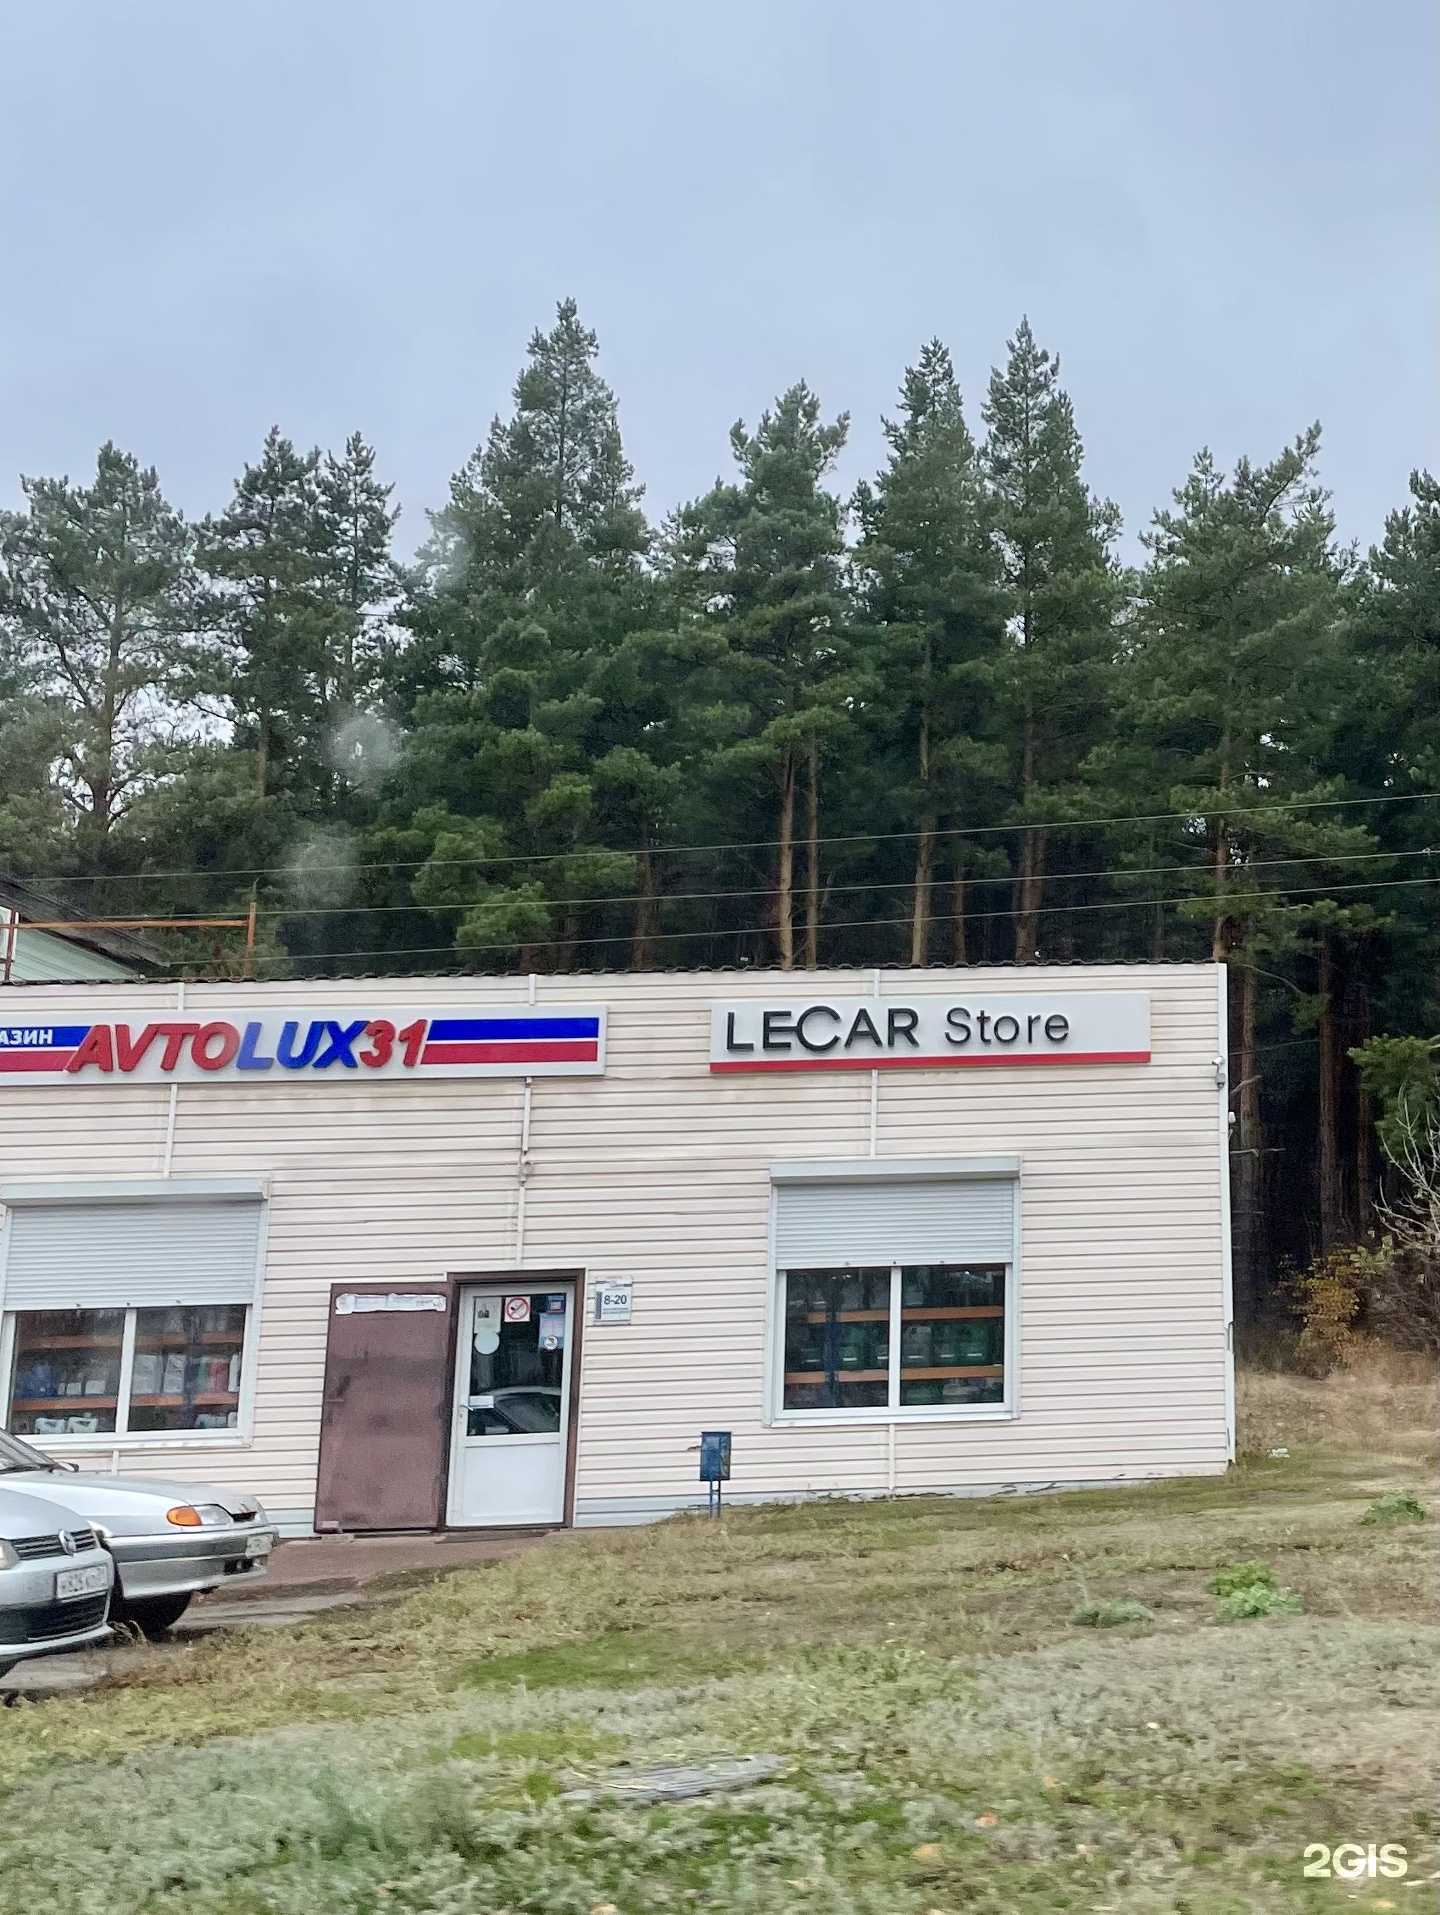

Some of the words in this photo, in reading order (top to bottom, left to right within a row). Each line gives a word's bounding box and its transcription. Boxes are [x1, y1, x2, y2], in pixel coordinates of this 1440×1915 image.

[64, 1018, 428, 1073] AVTOLUX31
[727, 1005, 919, 1051] LECAR
[945, 1007, 1070, 1044] Store
